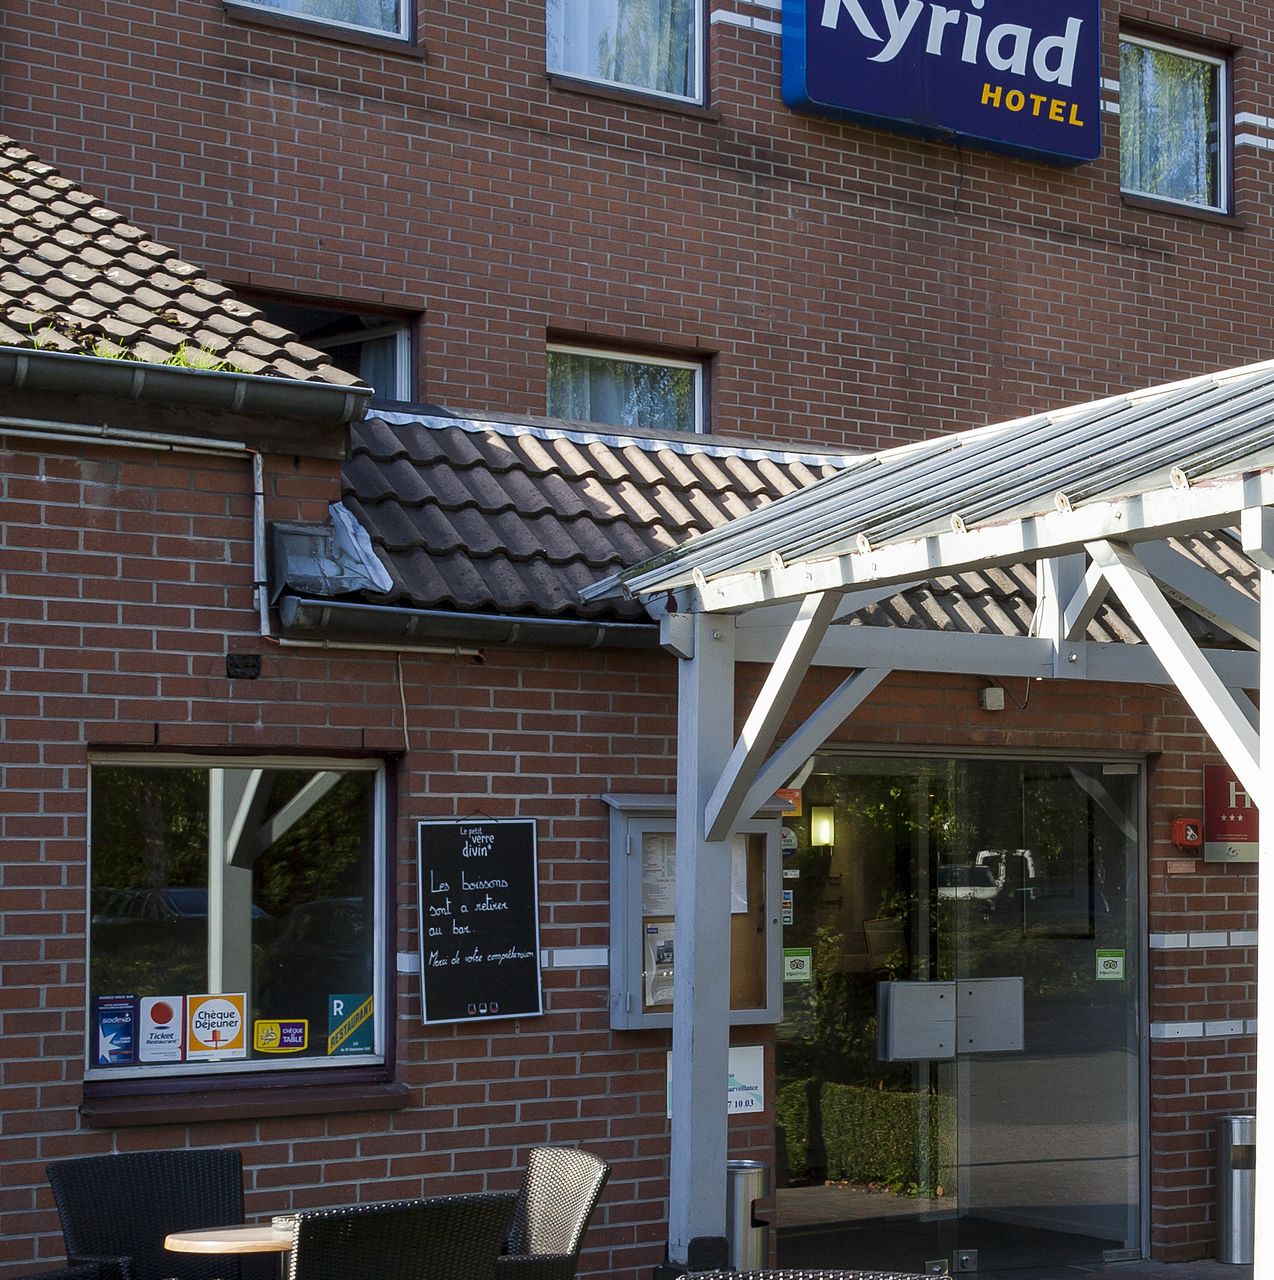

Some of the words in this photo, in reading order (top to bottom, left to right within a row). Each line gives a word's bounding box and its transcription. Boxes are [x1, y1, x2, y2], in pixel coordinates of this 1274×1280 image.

[980, 83, 1085, 128] HOTEL
[1228, 781, 1253, 809] H
[460, 826, 467, 835] Le
[468, 826, 483, 838] petit
[472, 834, 494, 844] verre
[430, 869, 450, 893] Les
[462, 870, 509, 891] boissons
[429, 897, 452, 917] sont
[474, 893, 509, 912] retirer
[428, 927, 443, 937] au
[428, 949, 449, 967] Merci
[451, 949, 460, 965] de
[465, 946, 483, 963] votre
[333, 1000, 344, 1016] R
[198, 1010, 236, 1020] Chèque
[195, 1020, 239, 1030] Déjeuner
[149, 1032, 175, 1040] Ticket
[282, 1036, 303, 1044] TABLE
[735, 1100, 743, 1108] 10
[745, 1099, 754, 1107] 03
